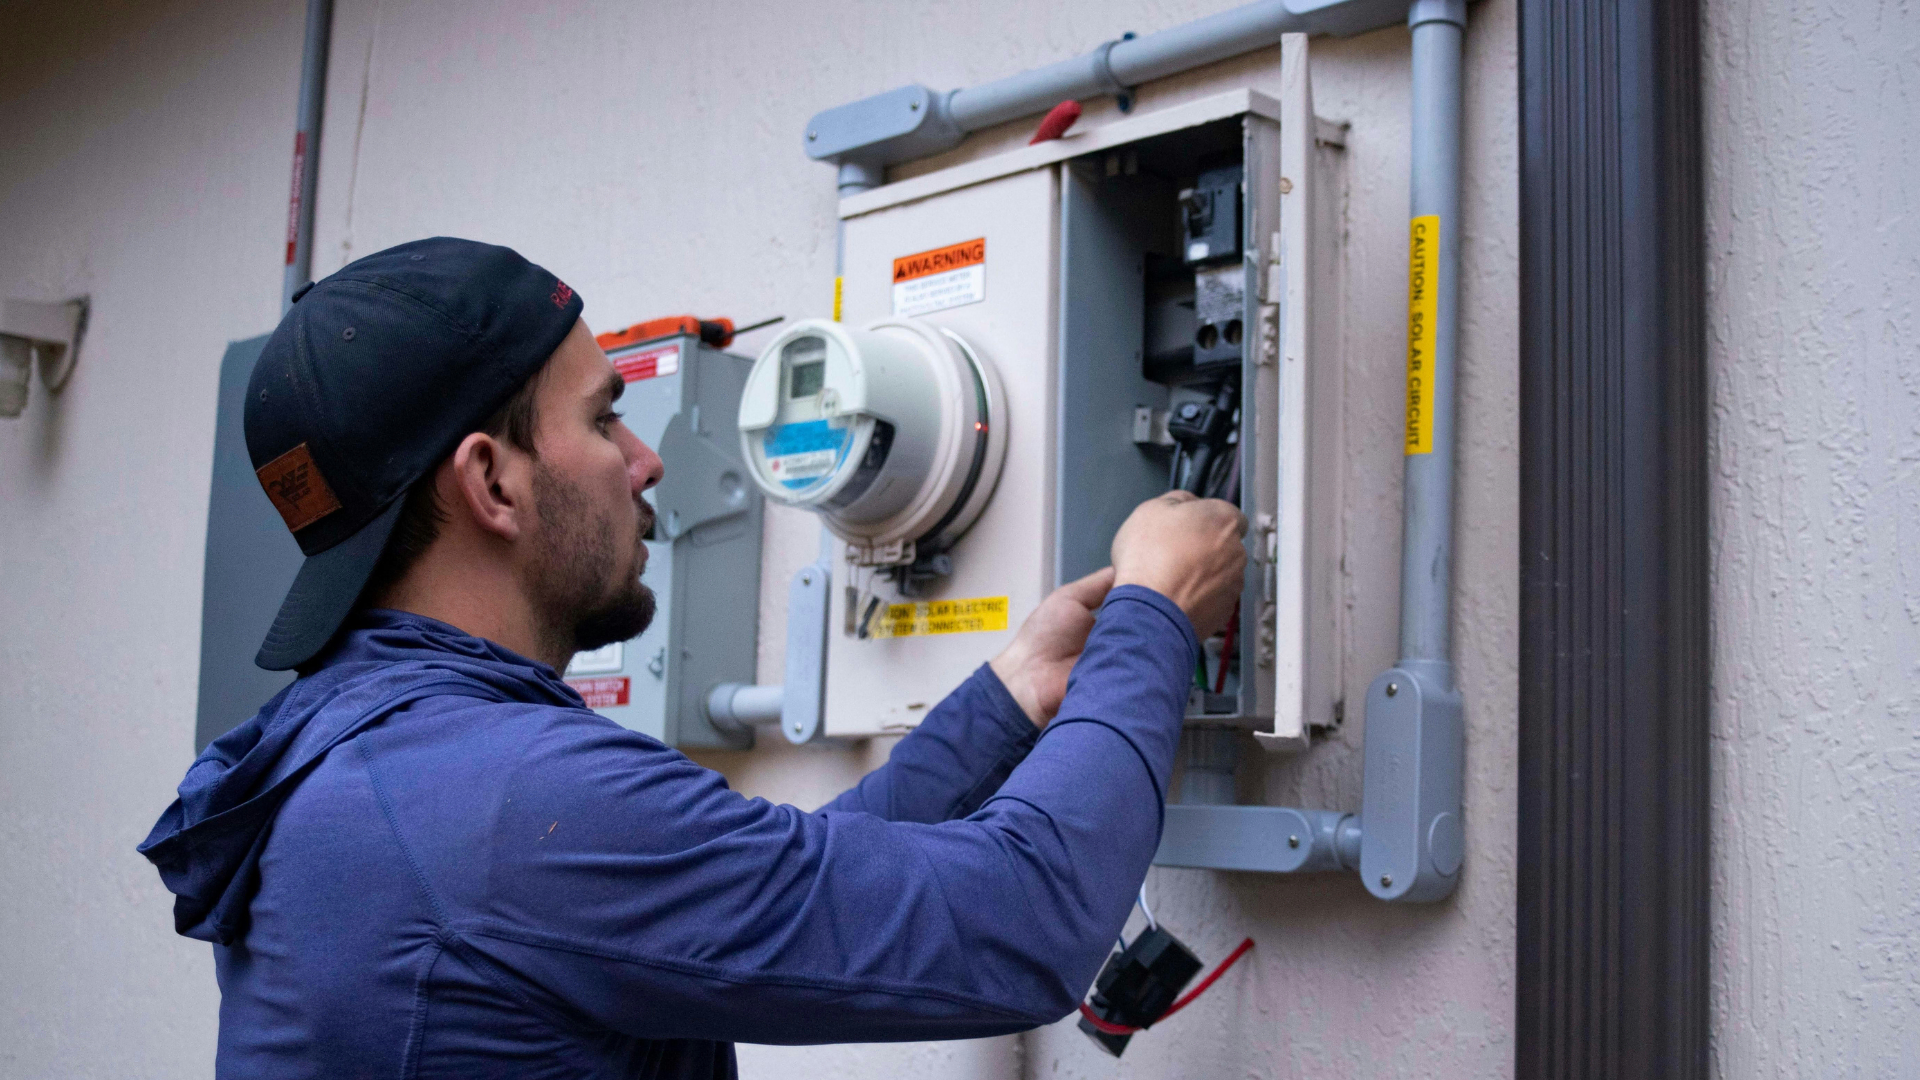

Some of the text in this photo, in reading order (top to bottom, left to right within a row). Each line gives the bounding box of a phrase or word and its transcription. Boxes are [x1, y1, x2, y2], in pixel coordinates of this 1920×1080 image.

[907, 243, 984, 276] WARNING
[1409, 312, 1424, 372] SOLAR
[1408, 377, 1422, 446] CIRCUIT
[953, 599, 1005, 616] ELECTRIC
